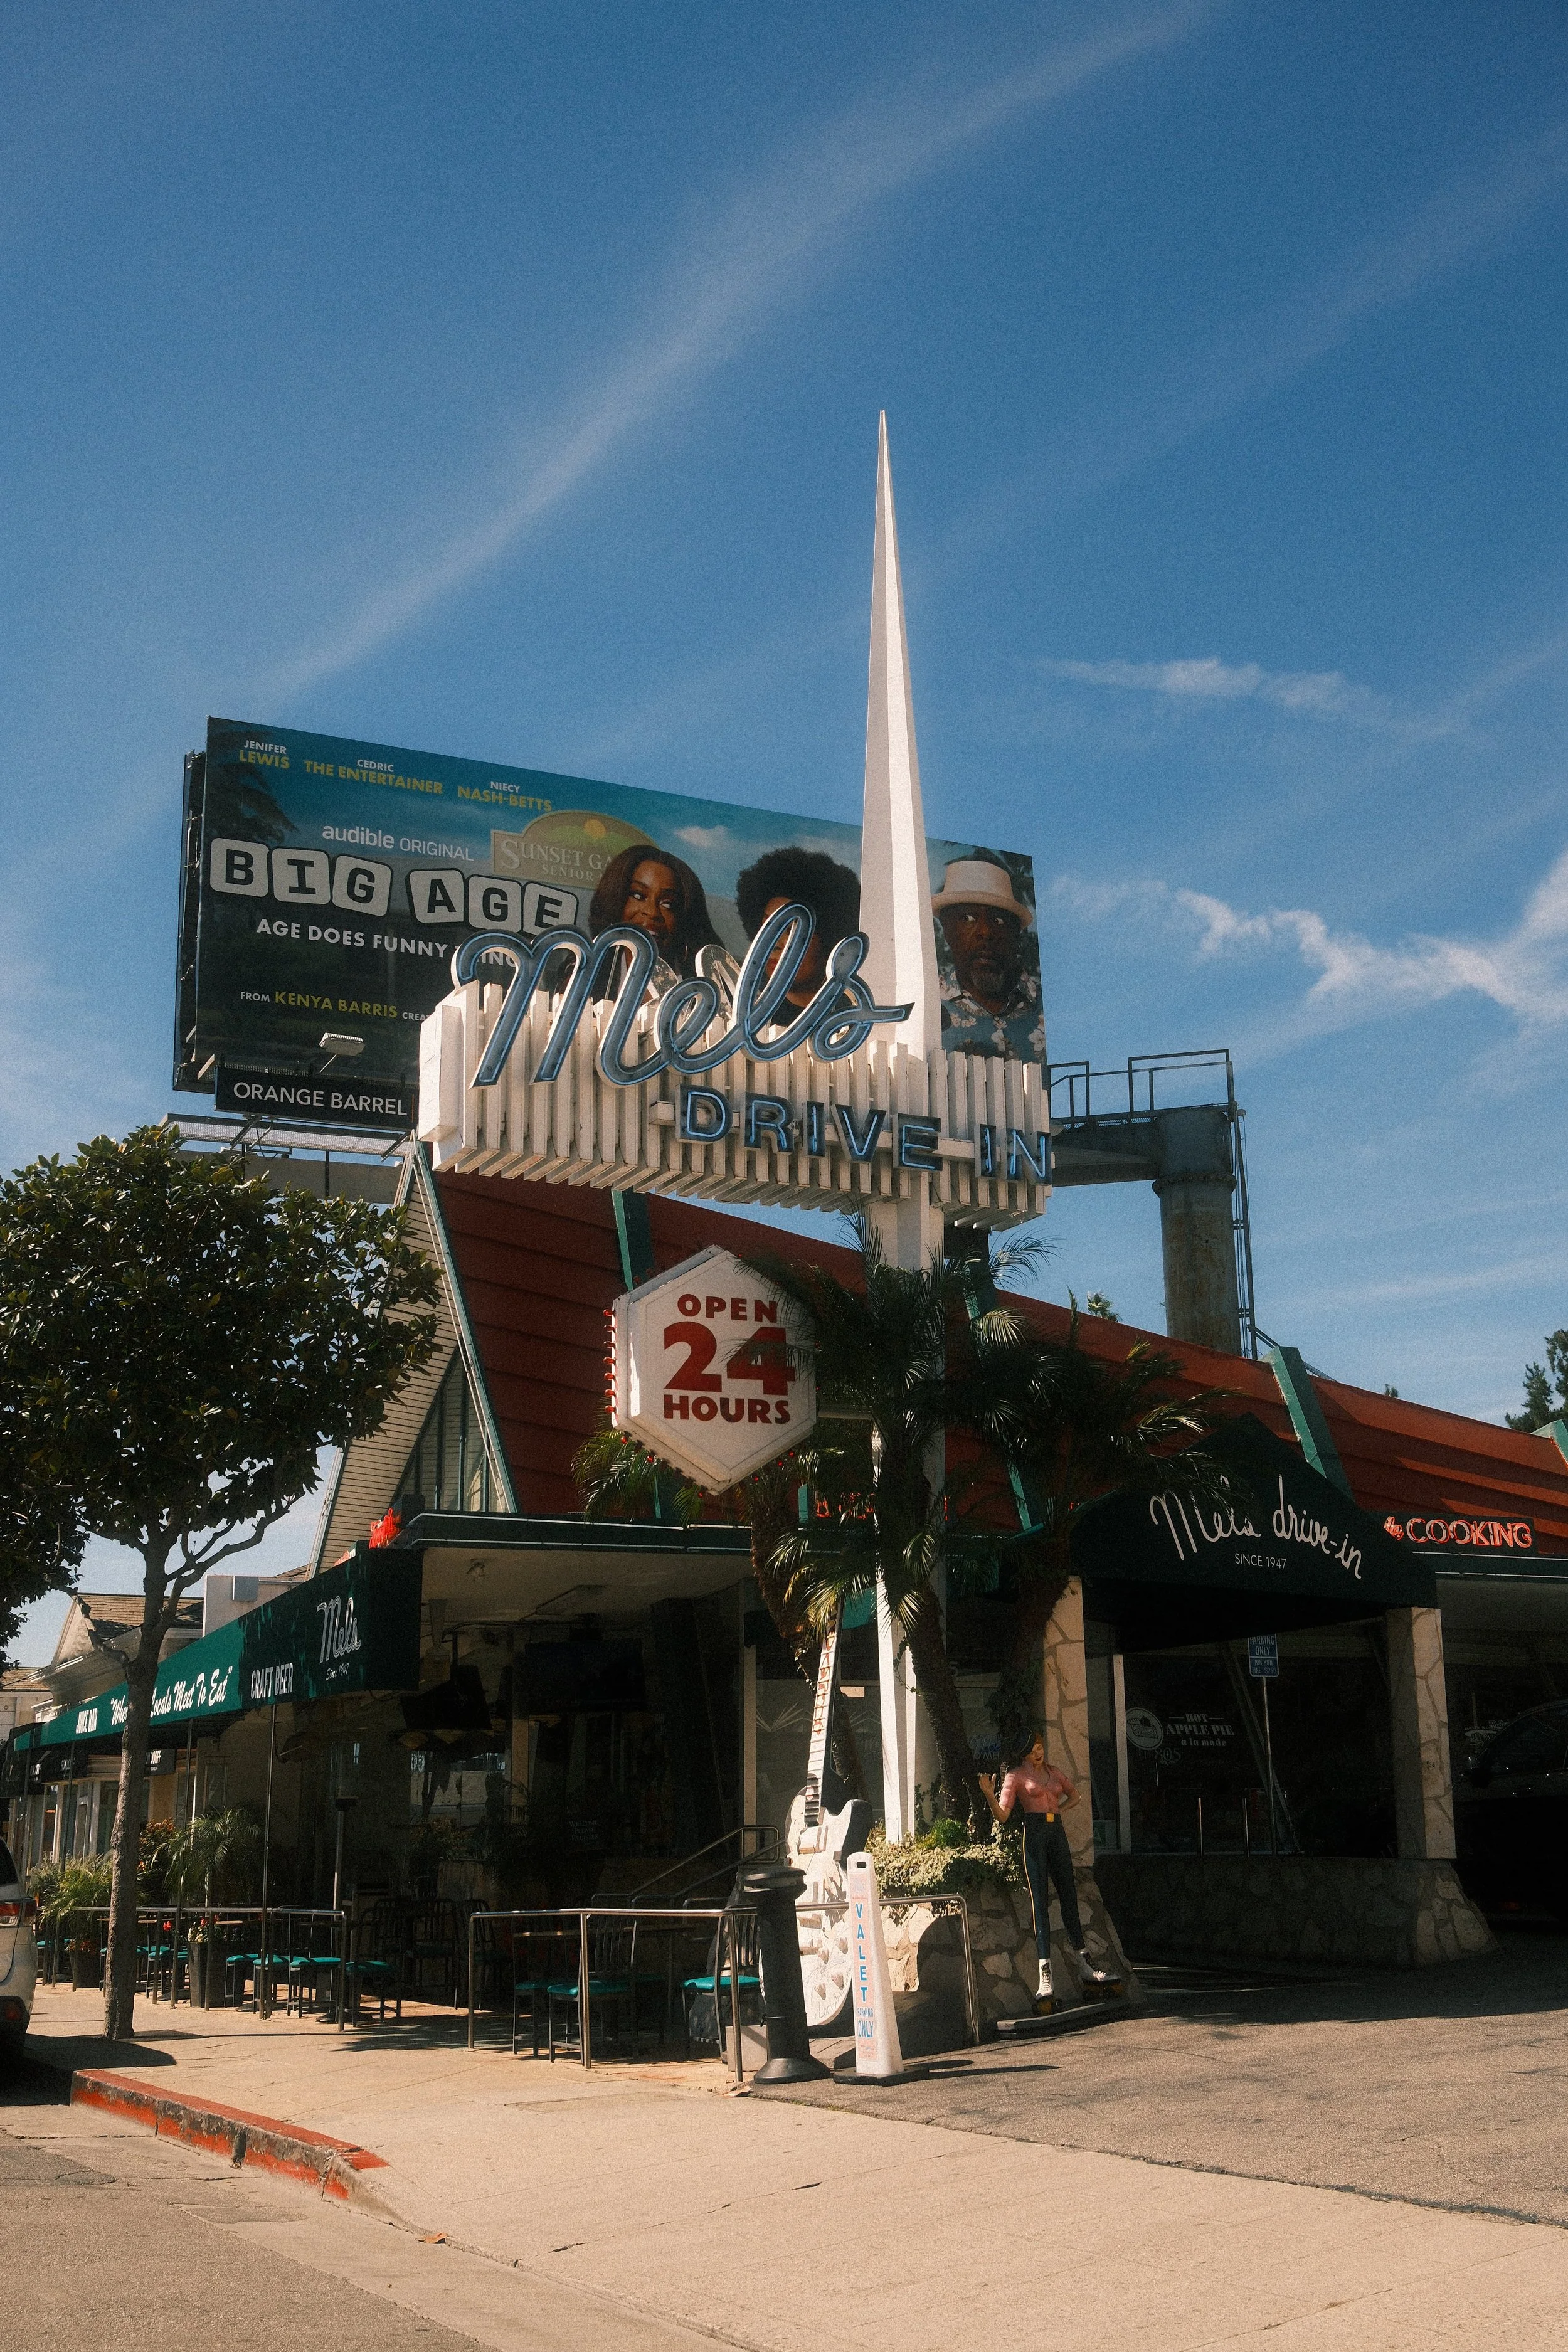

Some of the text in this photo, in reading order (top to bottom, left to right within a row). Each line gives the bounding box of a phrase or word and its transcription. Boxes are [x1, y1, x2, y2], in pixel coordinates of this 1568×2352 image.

[239, 750, 290, 769] LEWIS
[244, 739, 287, 755] JENIFER
[304, 760, 443, 794] THE ENTERTAINER
[356, 759, 394, 772] CEDRIC
[457, 785, 553, 812] NASH-BETTS
[490, 781, 521, 793] NIECY
[322, 825, 474, 862] audible ORIGINAL
[542, 864, 594, 881] SENIOR
[223, 848, 564, 930] BIG AGE
[256, 918, 300, 939] AGE
[308, 925, 365, 947] DOES
[373, 934, 447, 958] FUNNY
[241, 992, 270, 1002] FROM
[275, 991, 333, 1010] KENYA
[338, 999, 398, 1018] BARRIS
[451, 901, 916, 1089] Mels
[233, 1082, 407, 1116] ORANGE BARREL
[676, 1084, 1053, 1186] DRIVE IN
[677, 1293, 778, 1323] OPEN
[664, 1321, 795, 1396] 24
[664, 1394, 791, 1424] HOURS
[1273, 1474, 1362, 1579] drive-in
[1406, 1517, 1533, 1549] COOKING
[1234, 1552, 1287, 1569] SINCE 1947
[316, 1595, 361, 1664] Mels
[1249, 1636, 1275, 1645] PARKING
[1255, 1646, 1270, 1656] ONLY
[150, 1685, 172, 1718] Locals
[174, 1680, 194, 1711] Meet
[196, 1673, 206, 1707] To
[250, 1662, 294, 1699] CRAFT BEER
[1167, 1724, 1234, 1736] APPLE PIE
[1185, 1713, 1208, 1722] HOT
[1201, 1738, 1227, 1747] mode
[855, 1903, 868, 2003] VALET
[857, 2007, 874, 2018] PARKING
[858, 2020, 874, 2038] ONLY
